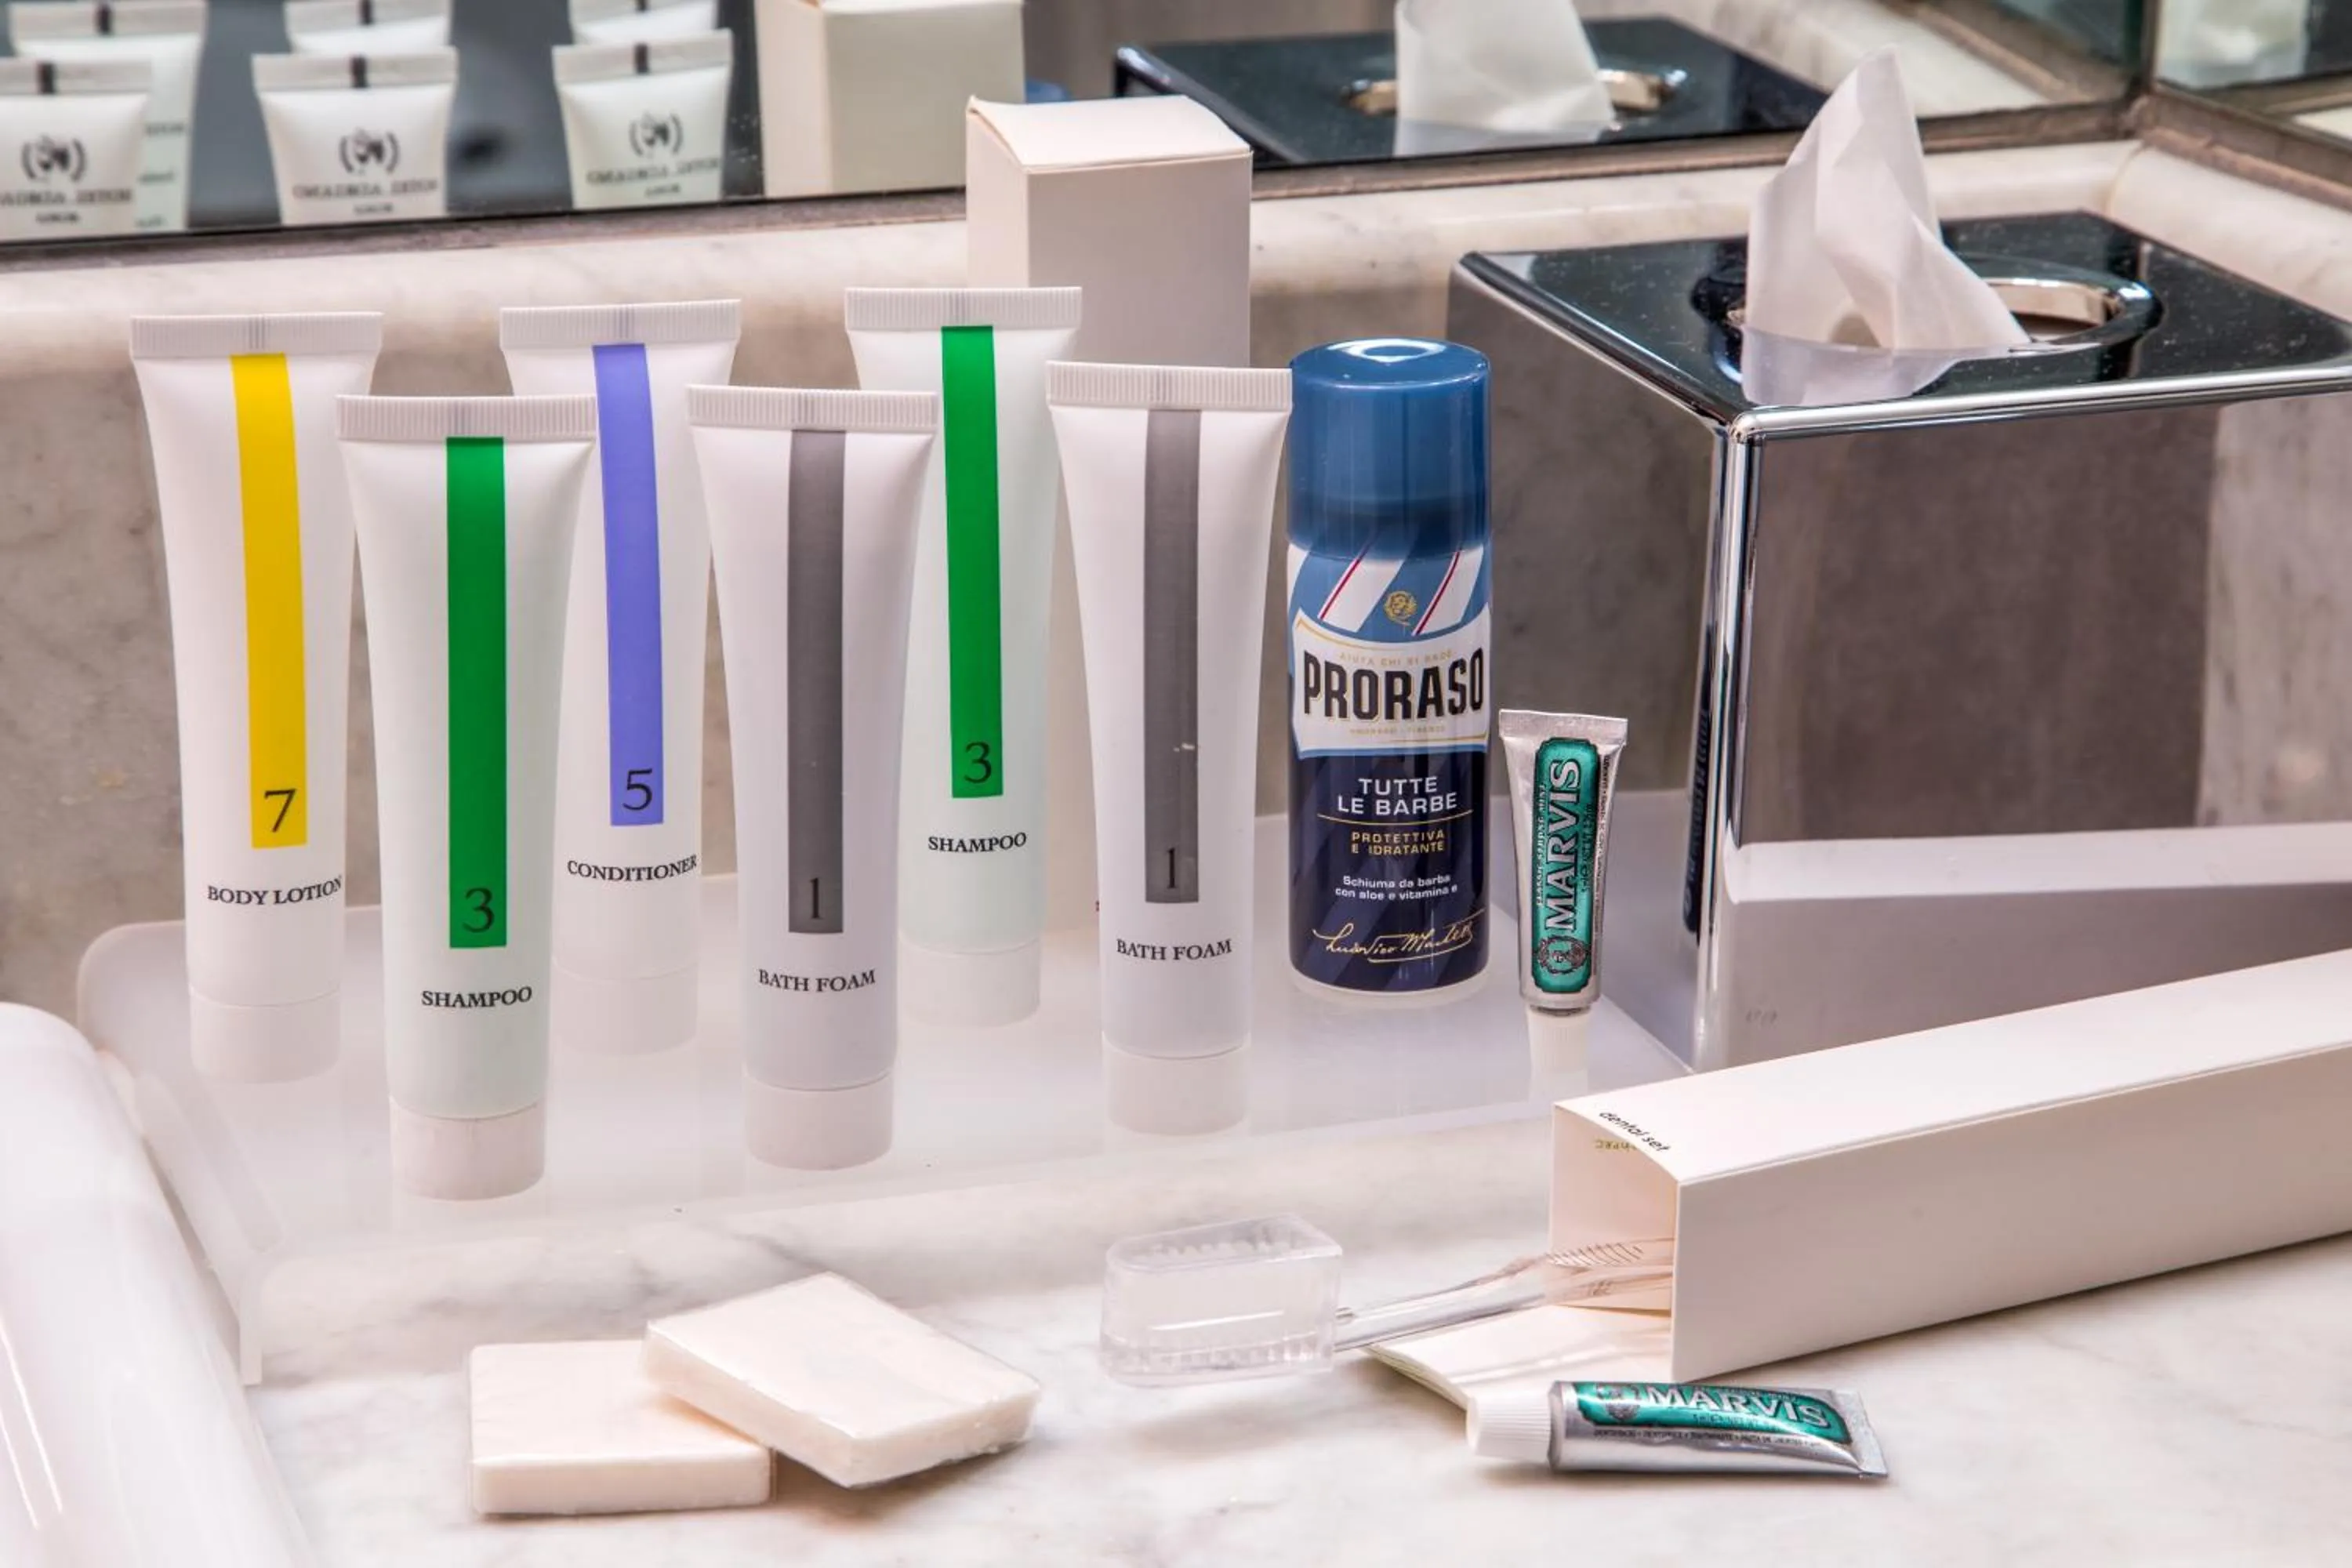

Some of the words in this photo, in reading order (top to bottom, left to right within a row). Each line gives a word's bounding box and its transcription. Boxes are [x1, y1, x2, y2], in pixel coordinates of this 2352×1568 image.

[1304, 647, 1484, 720] PRORASO
[964, 742, 992, 784] 3
[622, 768, 653, 811] 5
[1358, 776, 1437, 796] TUTTE
[264, 788, 297, 833] 7
[1338, 795, 1364, 815] LE
[1376, 792, 1457, 816] BARBE
[928, 832, 1027, 853] SHAMPOO
[1352, 829, 1445, 844] PROTETTIVA
[1352, 844, 1359, 854] E
[1368, 841, 1444, 856] IDRATANTE
[1544, 758, 1581, 931] MARVIS
[568, 855, 697, 881] CONDITIONER
[1166, 848, 1178, 889] 1
[1342, 875, 1396, 889] Schiuma
[1399, 877, 1414, 888] da
[1417, 874, 1450, 887] barba
[207, 885, 268, 906] BODY
[274, 875, 342, 905] LOTION
[809, 877, 824, 920] 1
[1335, 887, 1356, 898] con
[1359, 889, 1385, 900] aloe
[1388, 891, 1396, 900] e
[1399, 887, 1449, 901] vitamina
[462, 887, 495, 933] 3
[1116, 938, 1166, 960] BATH
[1172, 938, 1232, 960] FOAM
[758, 969, 810, 992] BATH
[816, 969, 876, 993] FOAM
[422, 986, 533, 1008] SHAMPOO
[1599, 1112, 1650, 1137] dental
[1641, 1136, 1671, 1151] set
[1646, 1385, 1832, 1429] MARVIS
